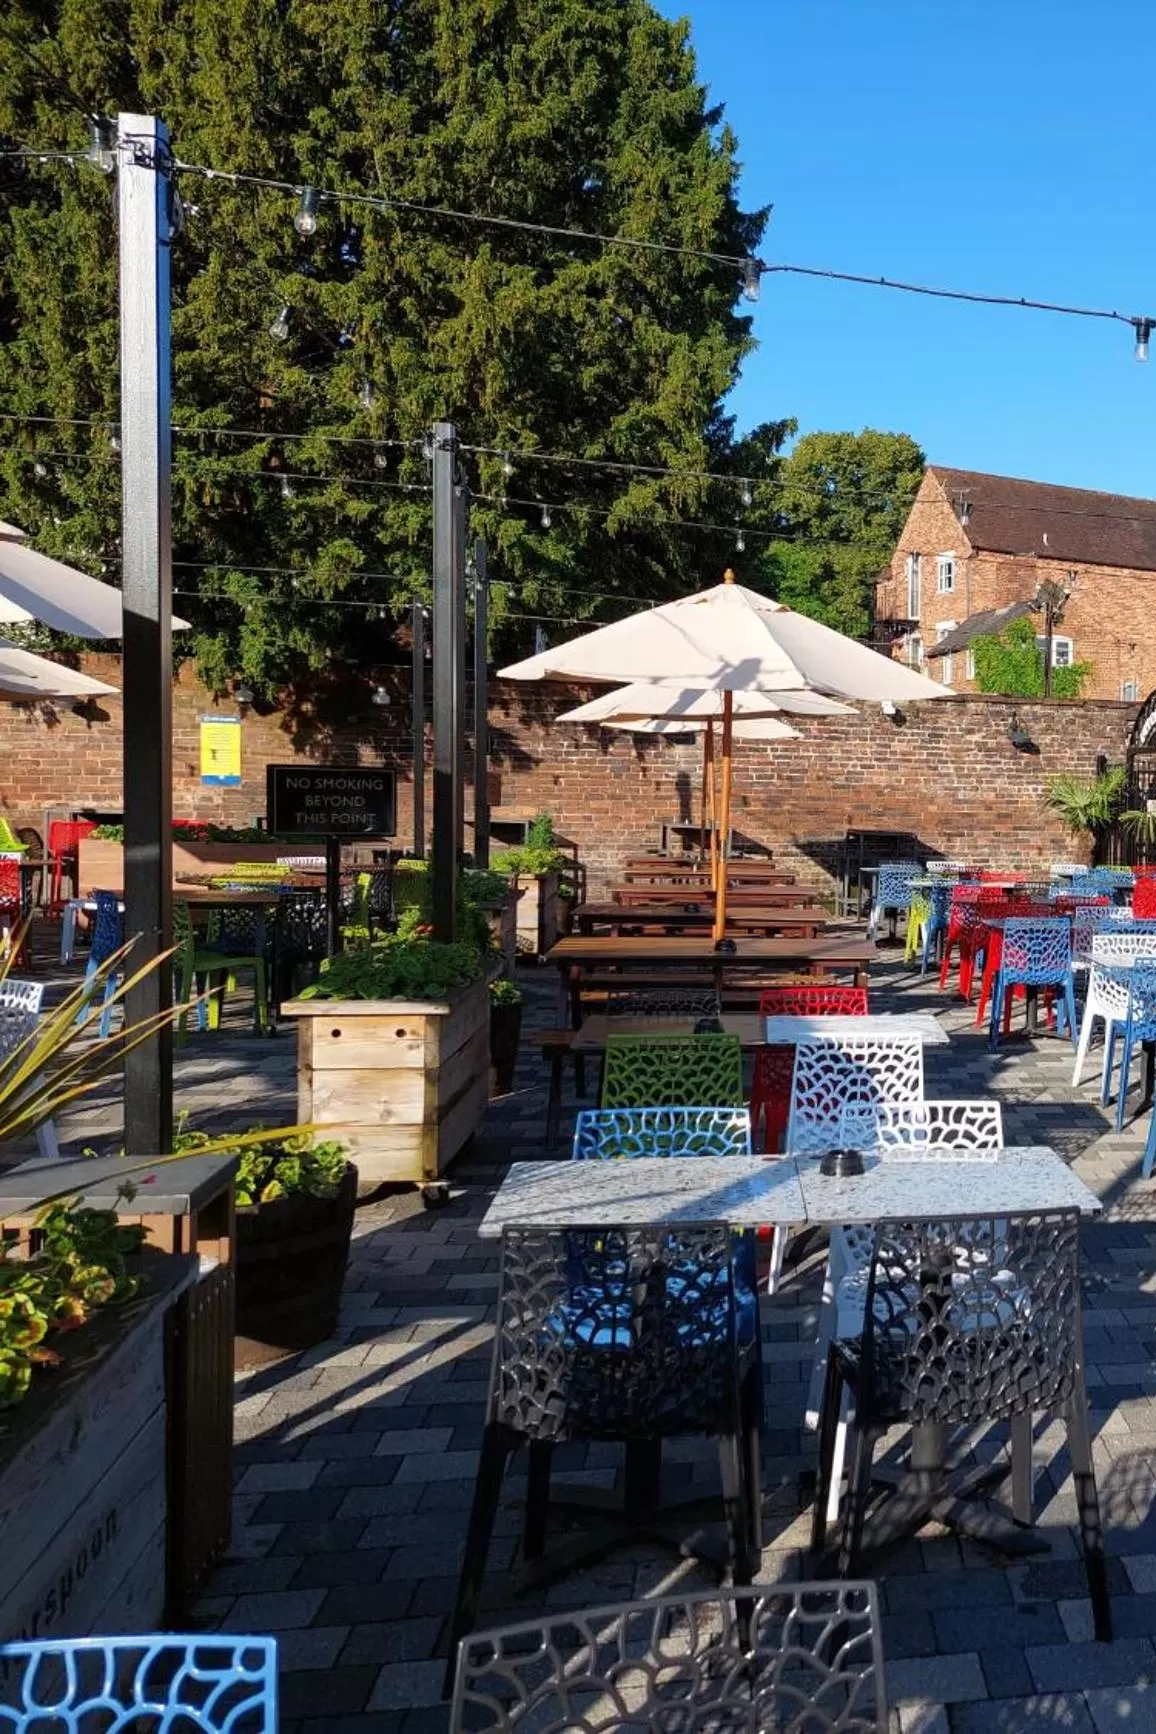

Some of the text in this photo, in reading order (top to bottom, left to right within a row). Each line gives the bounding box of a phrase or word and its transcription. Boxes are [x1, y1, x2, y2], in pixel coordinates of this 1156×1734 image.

[285, 777, 384, 790] NO SMOKING
[305, 795, 366, 807] BEYOND
[294, 812, 377, 826] THIS POINT
[20, 1507, 118, 1640] rspoon
